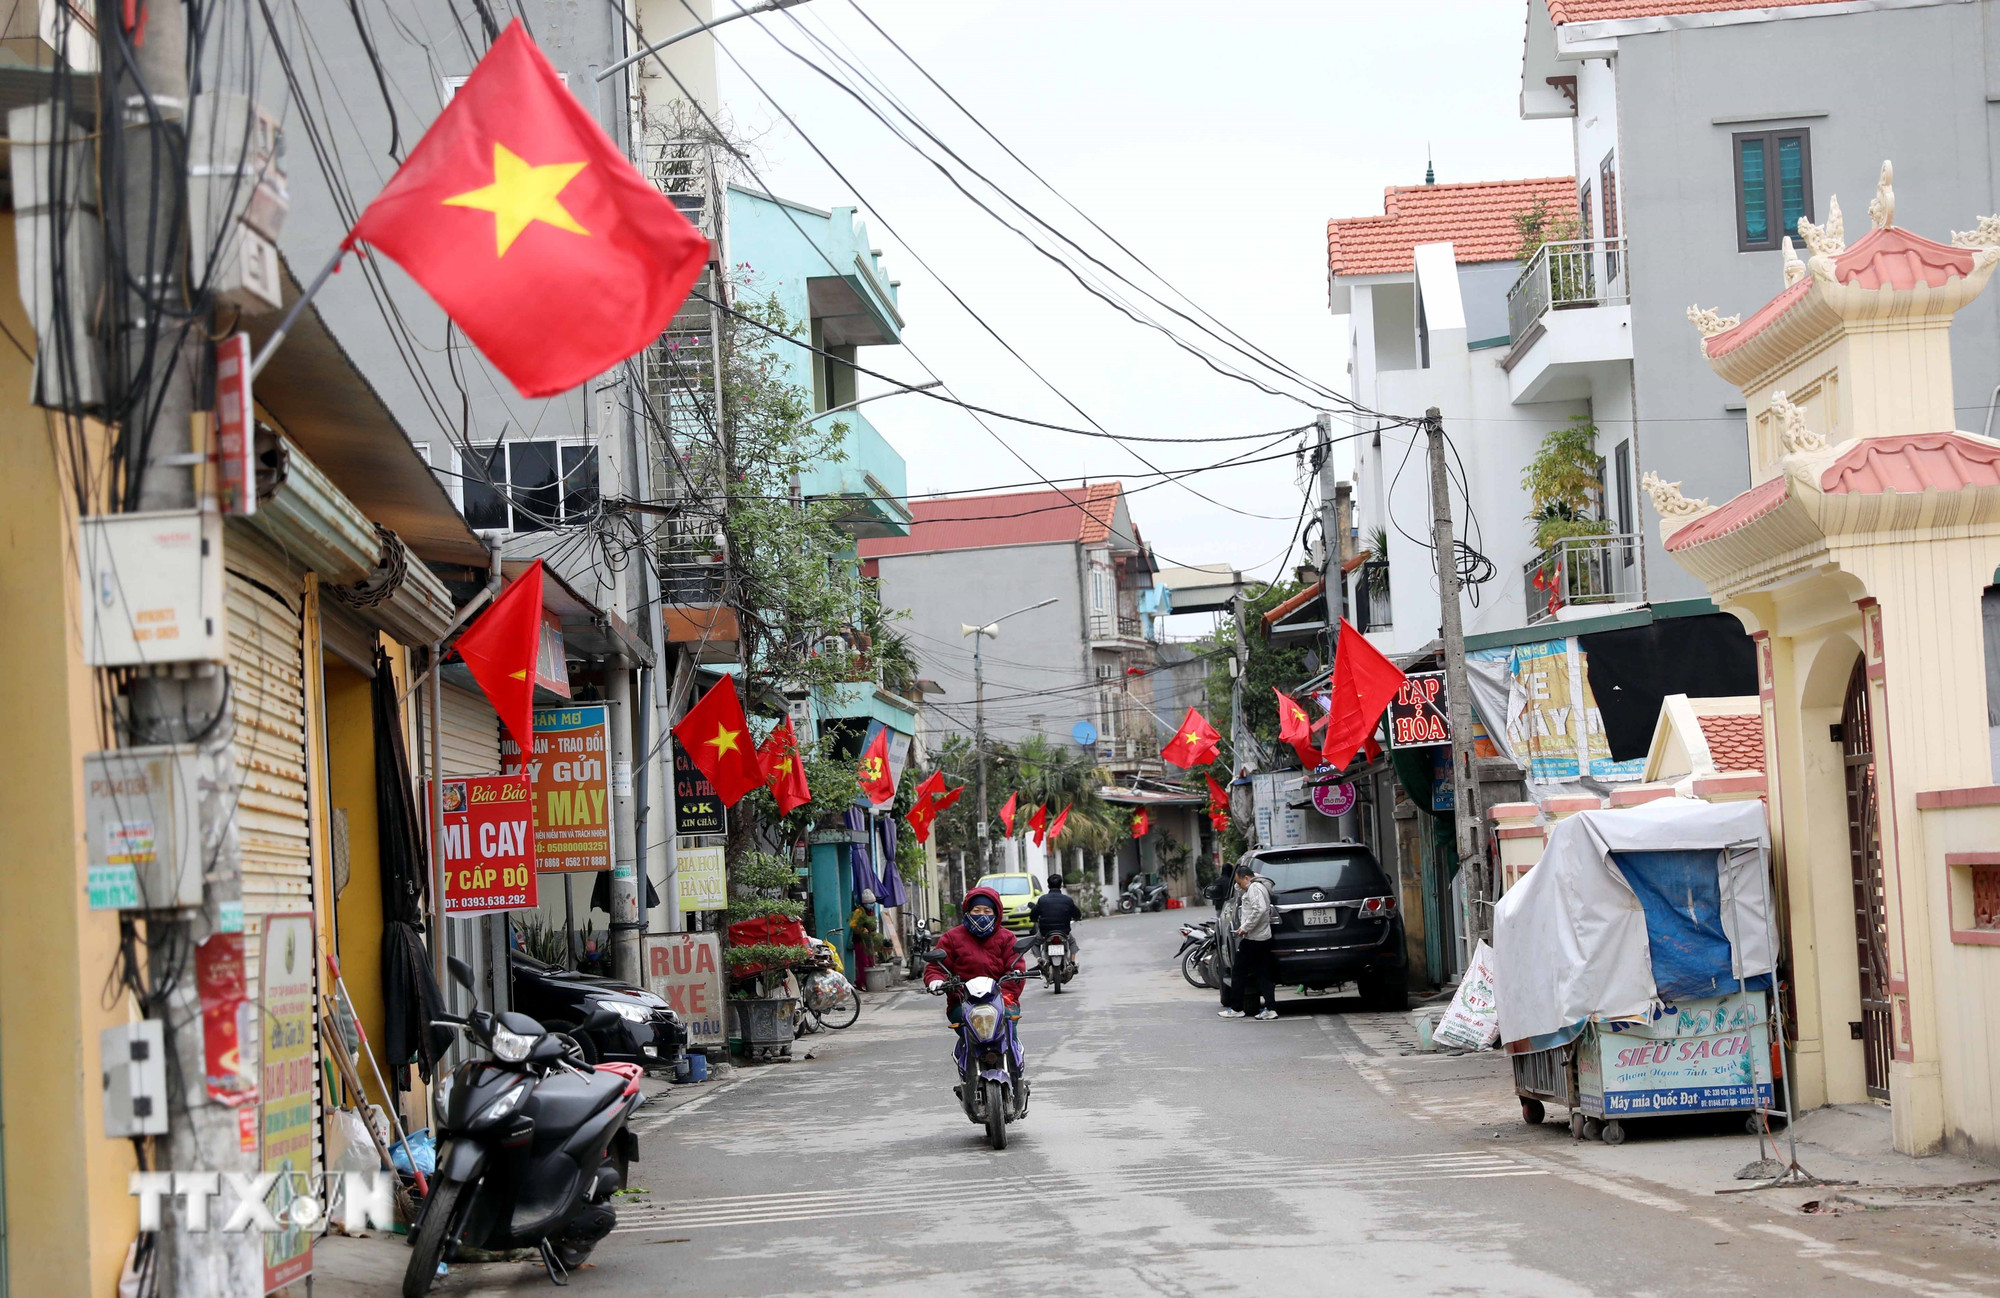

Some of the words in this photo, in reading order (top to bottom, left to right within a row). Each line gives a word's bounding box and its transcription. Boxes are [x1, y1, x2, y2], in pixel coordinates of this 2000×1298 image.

[1398, 679, 1439, 710] TẠP
[1396, 710, 1446, 742] HÓA
[531, 736, 548, 754] ÁN
[558, 737, 583, 753] TRAO
[586, 730, 603, 752] ĐỔI
[553, 754, 601, 782] GỬI
[471, 785, 497, 803] Bảo
[501, 783, 528, 801] Bảo
[678, 777, 693, 797] CÀ
[547, 782, 606, 826] MÁY
[682, 818, 695, 827] XIN
[697, 816, 718, 826] CHÀO
[443, 816, 471, 860] MÌ
[480, 820, 528, 858] CAY
[559, 830, 568, 839] TIN
[568, 829, 575, 838] VÀ
[575, 828, 590, 838] TRÁCH
[591, 827, 607, 839] NHIỆM
[534, 841, 545, 853] Ố:
[582, 857, 590, 866] 17
[677, 856, 696, 872] BIA
[445, 871, 453, 891] 7
[460, 863, 497, 890] CẤP
[503, 863, 529, 891] ĐỘ
[680, 876, 698, 896] HÀ
[699, 876, 721, 898] NỘI
[461, 894, 526, 907] 0393.638.292
[1307, 916, 1332, 924] 271.61
[650, 934, 716, 977] RỬA
[666, 983, 707, 1015] XE
[1676, 1035, 1749, 1065] SẠCH
[1610, 1095, 1630, 1111] Máy
[1632, 1093, 1650, 1107] mía
[1652, 1090, 1679, 1107] Quốc
[1680, 1093, 1699, 1109] Đạt
